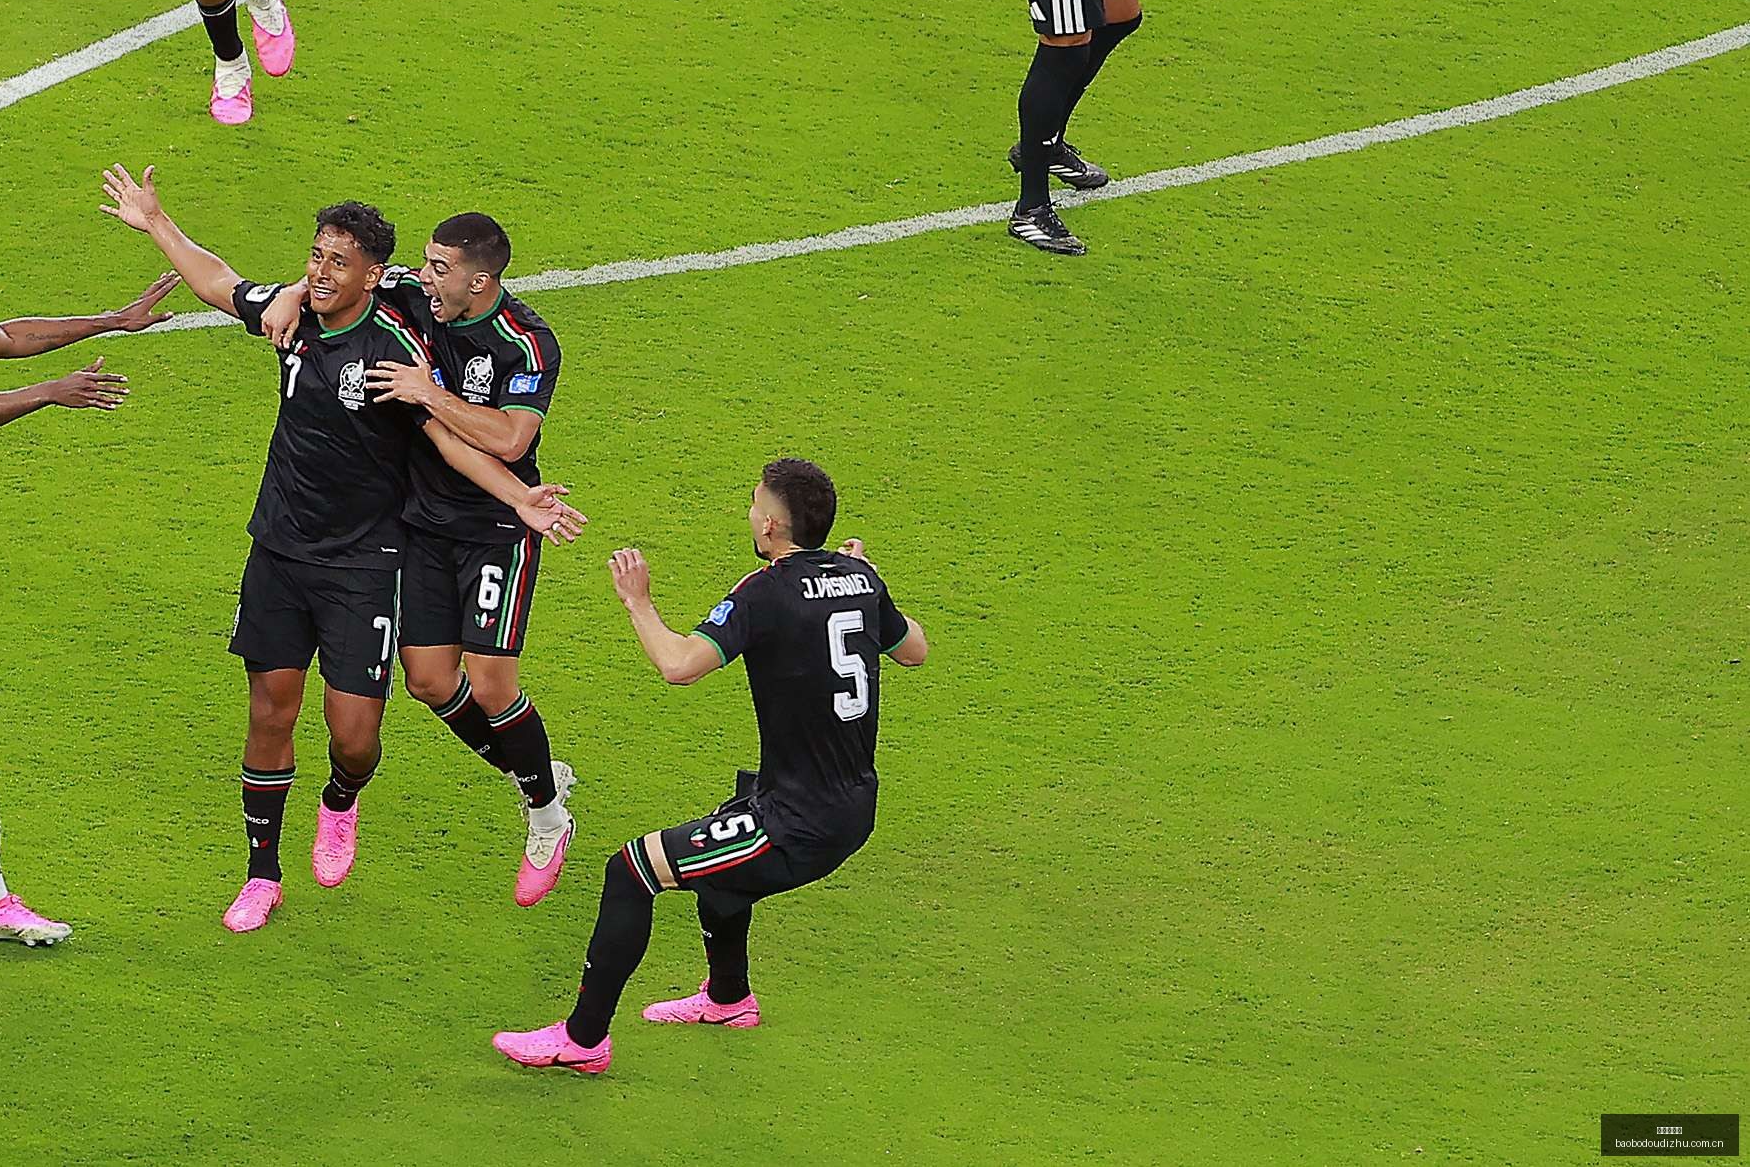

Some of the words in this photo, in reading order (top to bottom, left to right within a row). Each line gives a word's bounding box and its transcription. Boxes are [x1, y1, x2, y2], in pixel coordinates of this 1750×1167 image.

[284, 353, 303, 399] 7
[478, 564, 503, 610] 6
[373, 616, 391, 662] 7
[827, 609, 869, 722] 5
[710, 814, 756, 841] 5
